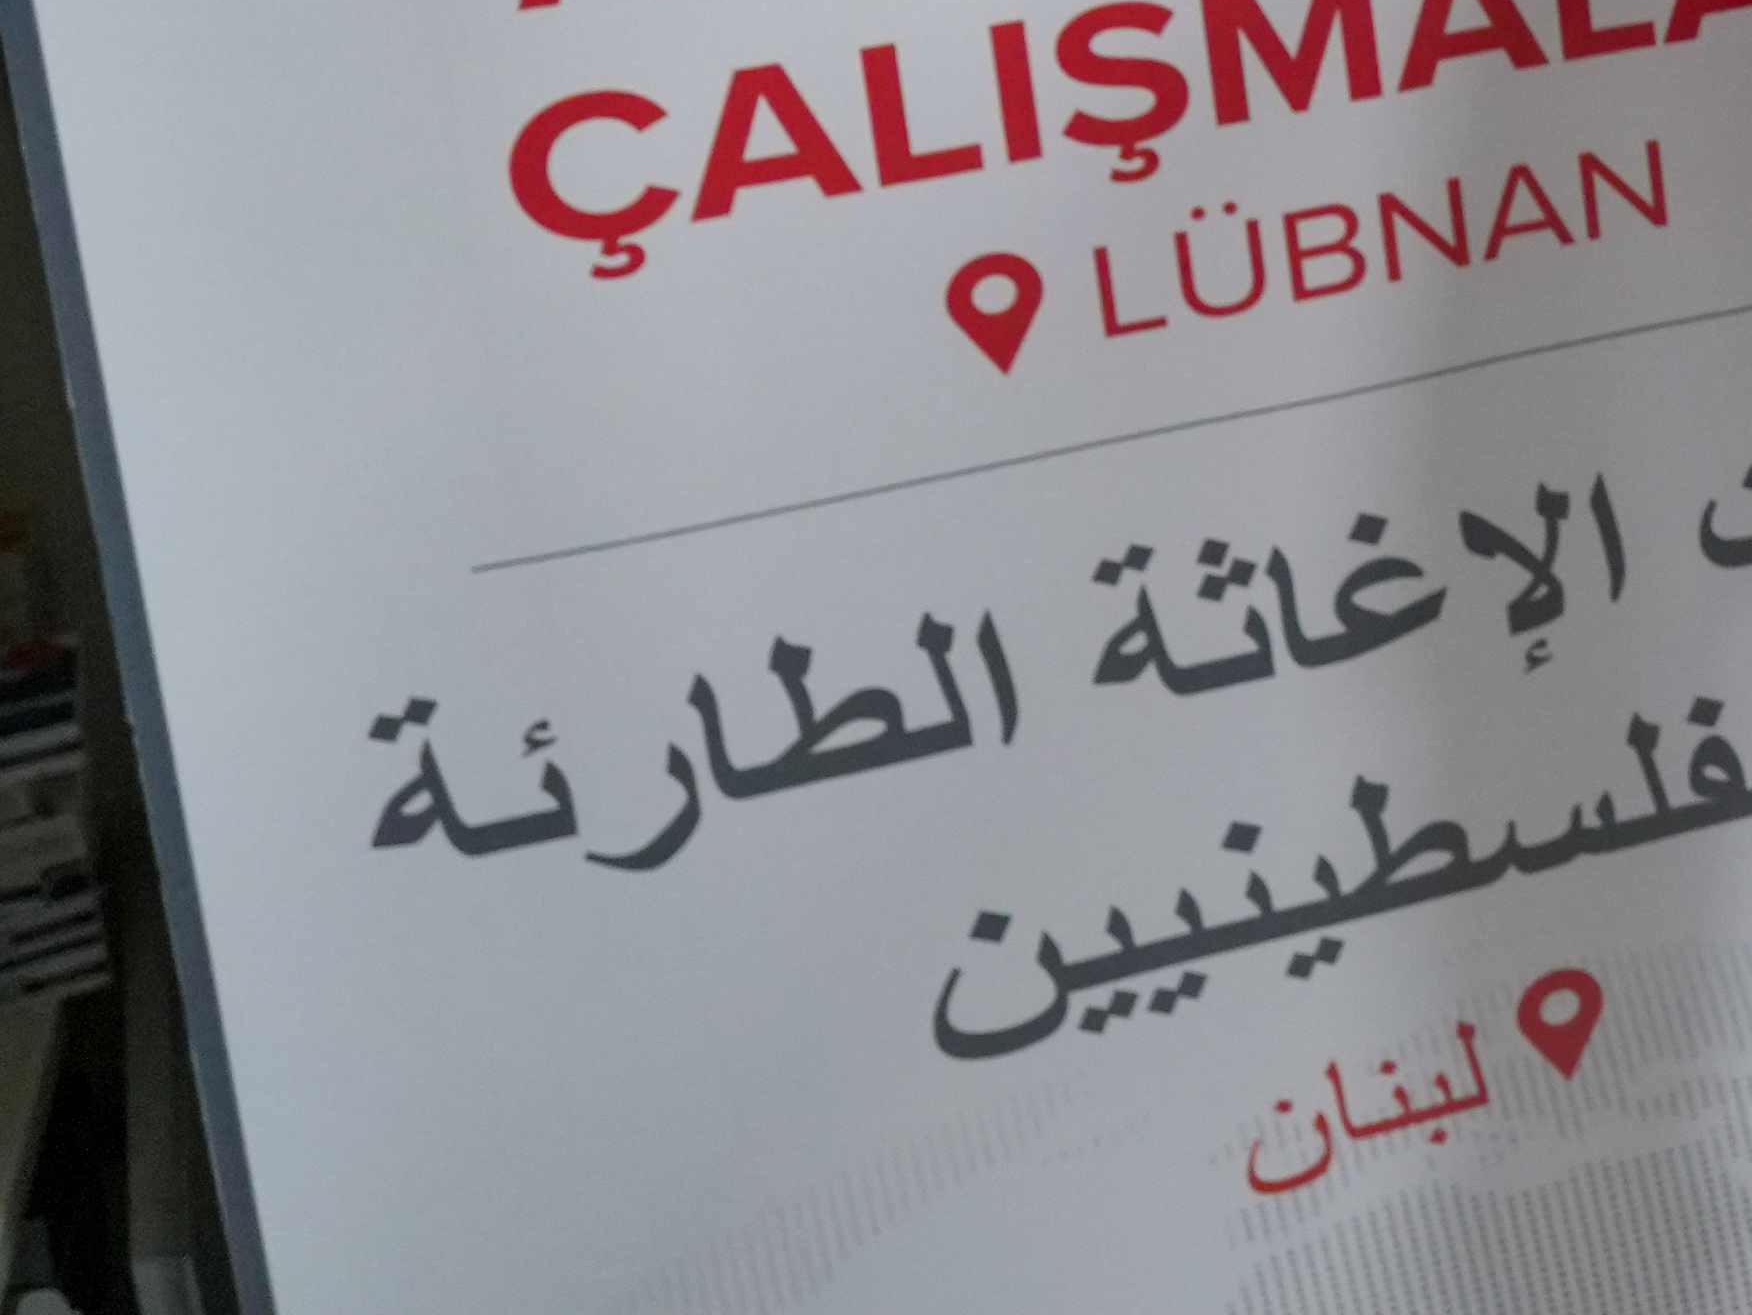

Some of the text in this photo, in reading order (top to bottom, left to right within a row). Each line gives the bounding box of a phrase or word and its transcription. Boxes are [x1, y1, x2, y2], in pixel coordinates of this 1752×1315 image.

[1091, 139, 1672, 341] LÜBNAN
[1093, 471, 1628, 694] الإغاثة
[370, 610, 1020, 873] الطارئة
[1243, 1023, 1489, 1194] لبنان
